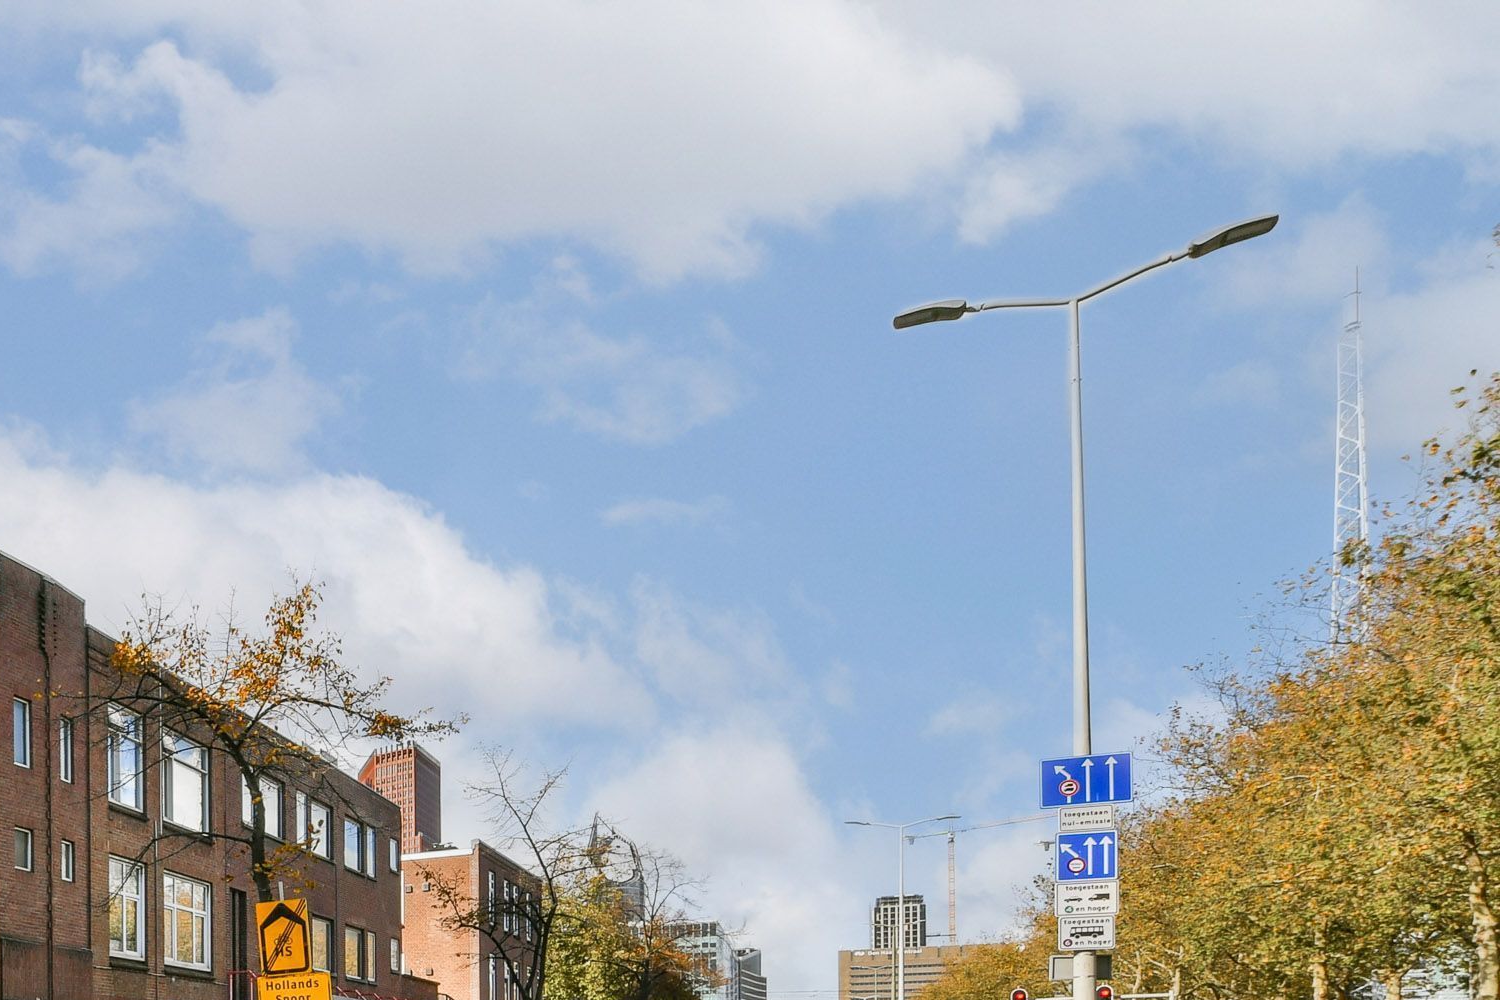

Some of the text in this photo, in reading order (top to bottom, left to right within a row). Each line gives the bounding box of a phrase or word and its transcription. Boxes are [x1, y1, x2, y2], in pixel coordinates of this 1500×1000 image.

[1064, 810, 1109, 818] toegestaan
[1065, 884, 1109, 892] toegestaan
[266, 978, 319, 991] Hollands
